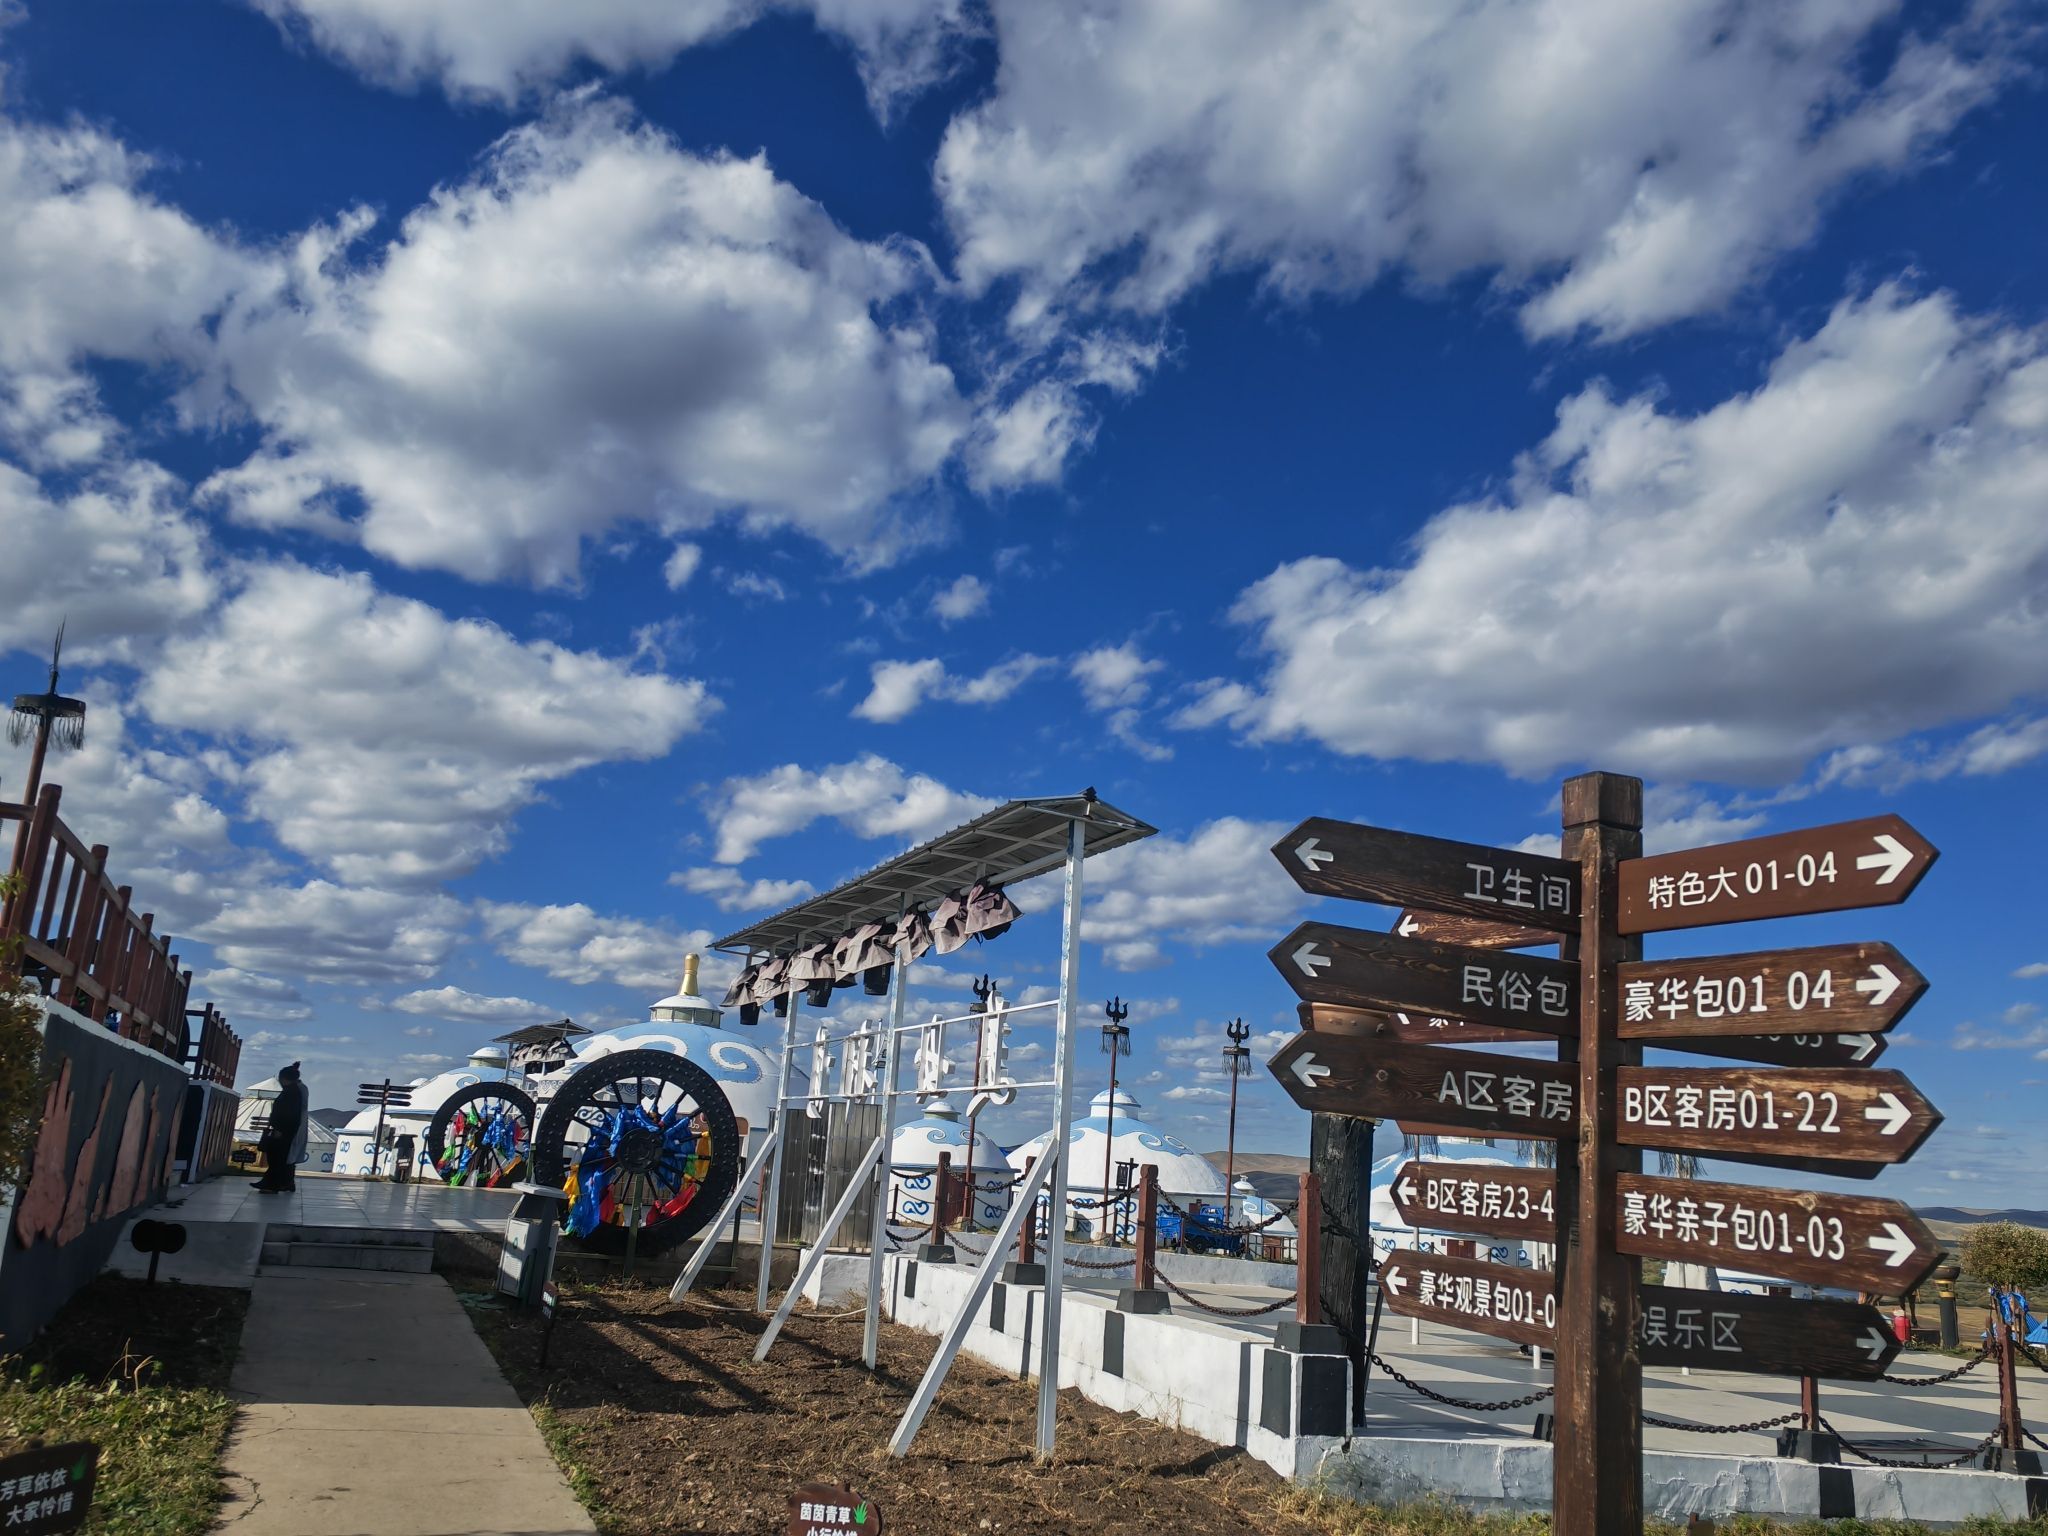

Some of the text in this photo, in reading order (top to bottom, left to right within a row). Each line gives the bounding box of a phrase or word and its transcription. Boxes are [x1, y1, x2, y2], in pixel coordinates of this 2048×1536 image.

[1464, 863, 1571, 915] 卫生间
[1462, 965, 1570, 1017] 民俗包
[1438, 1070, 1573, 1122] A区客房
[1625, 1085, 1841, 1133] B区客房01-22
[1624, 1190, 1845, 1260] 豪华亲子包01-03
[1641, 1306, 1743, 1352] 娱乐区
[0, 1467, 67, 1501] 芳草依依
